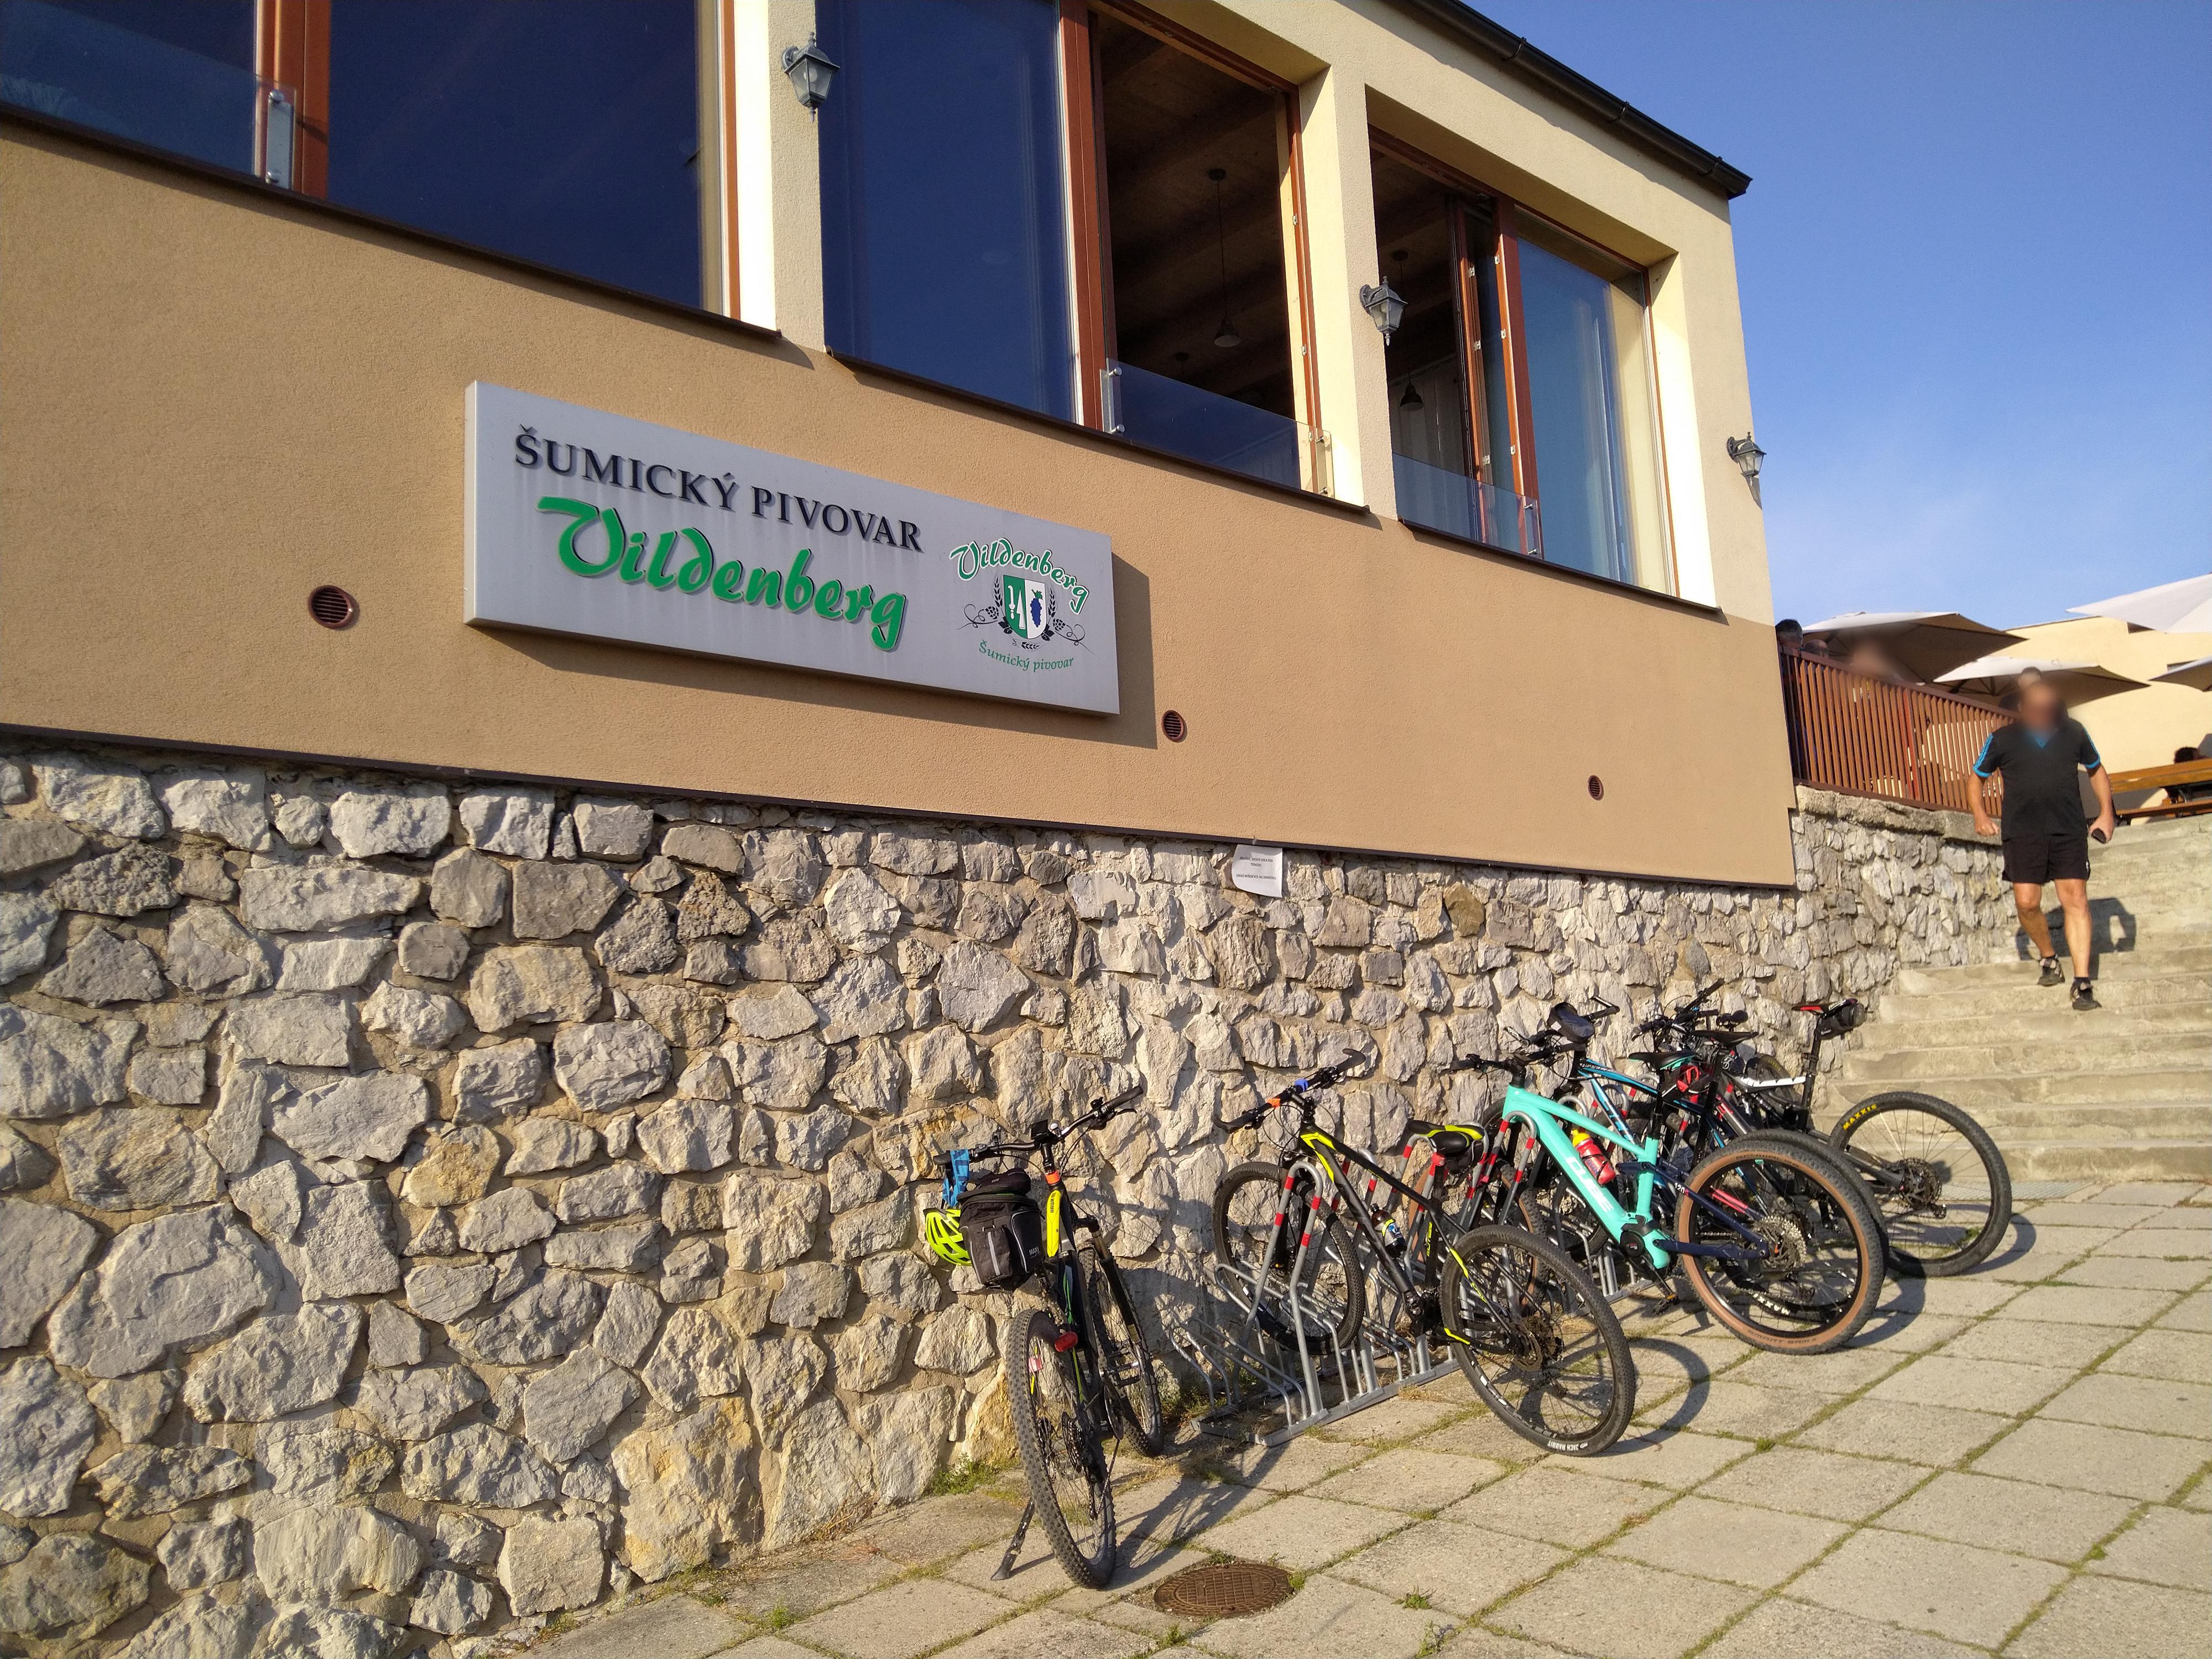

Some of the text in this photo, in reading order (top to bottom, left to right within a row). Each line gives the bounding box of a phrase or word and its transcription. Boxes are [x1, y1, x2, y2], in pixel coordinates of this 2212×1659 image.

[515, 424, 924, 552] ŠUMICKÝ PIVOVAR
[536, 495, 907, 651] Vildenberg
[949, 538, 1089, 614] Vildenberg
[979, 640, 1074, 672] Šumický pivovar
[1843, 1103, 1877, 1130] MAXXIS
[1566, 1156, 1614, 1213] CUBE
